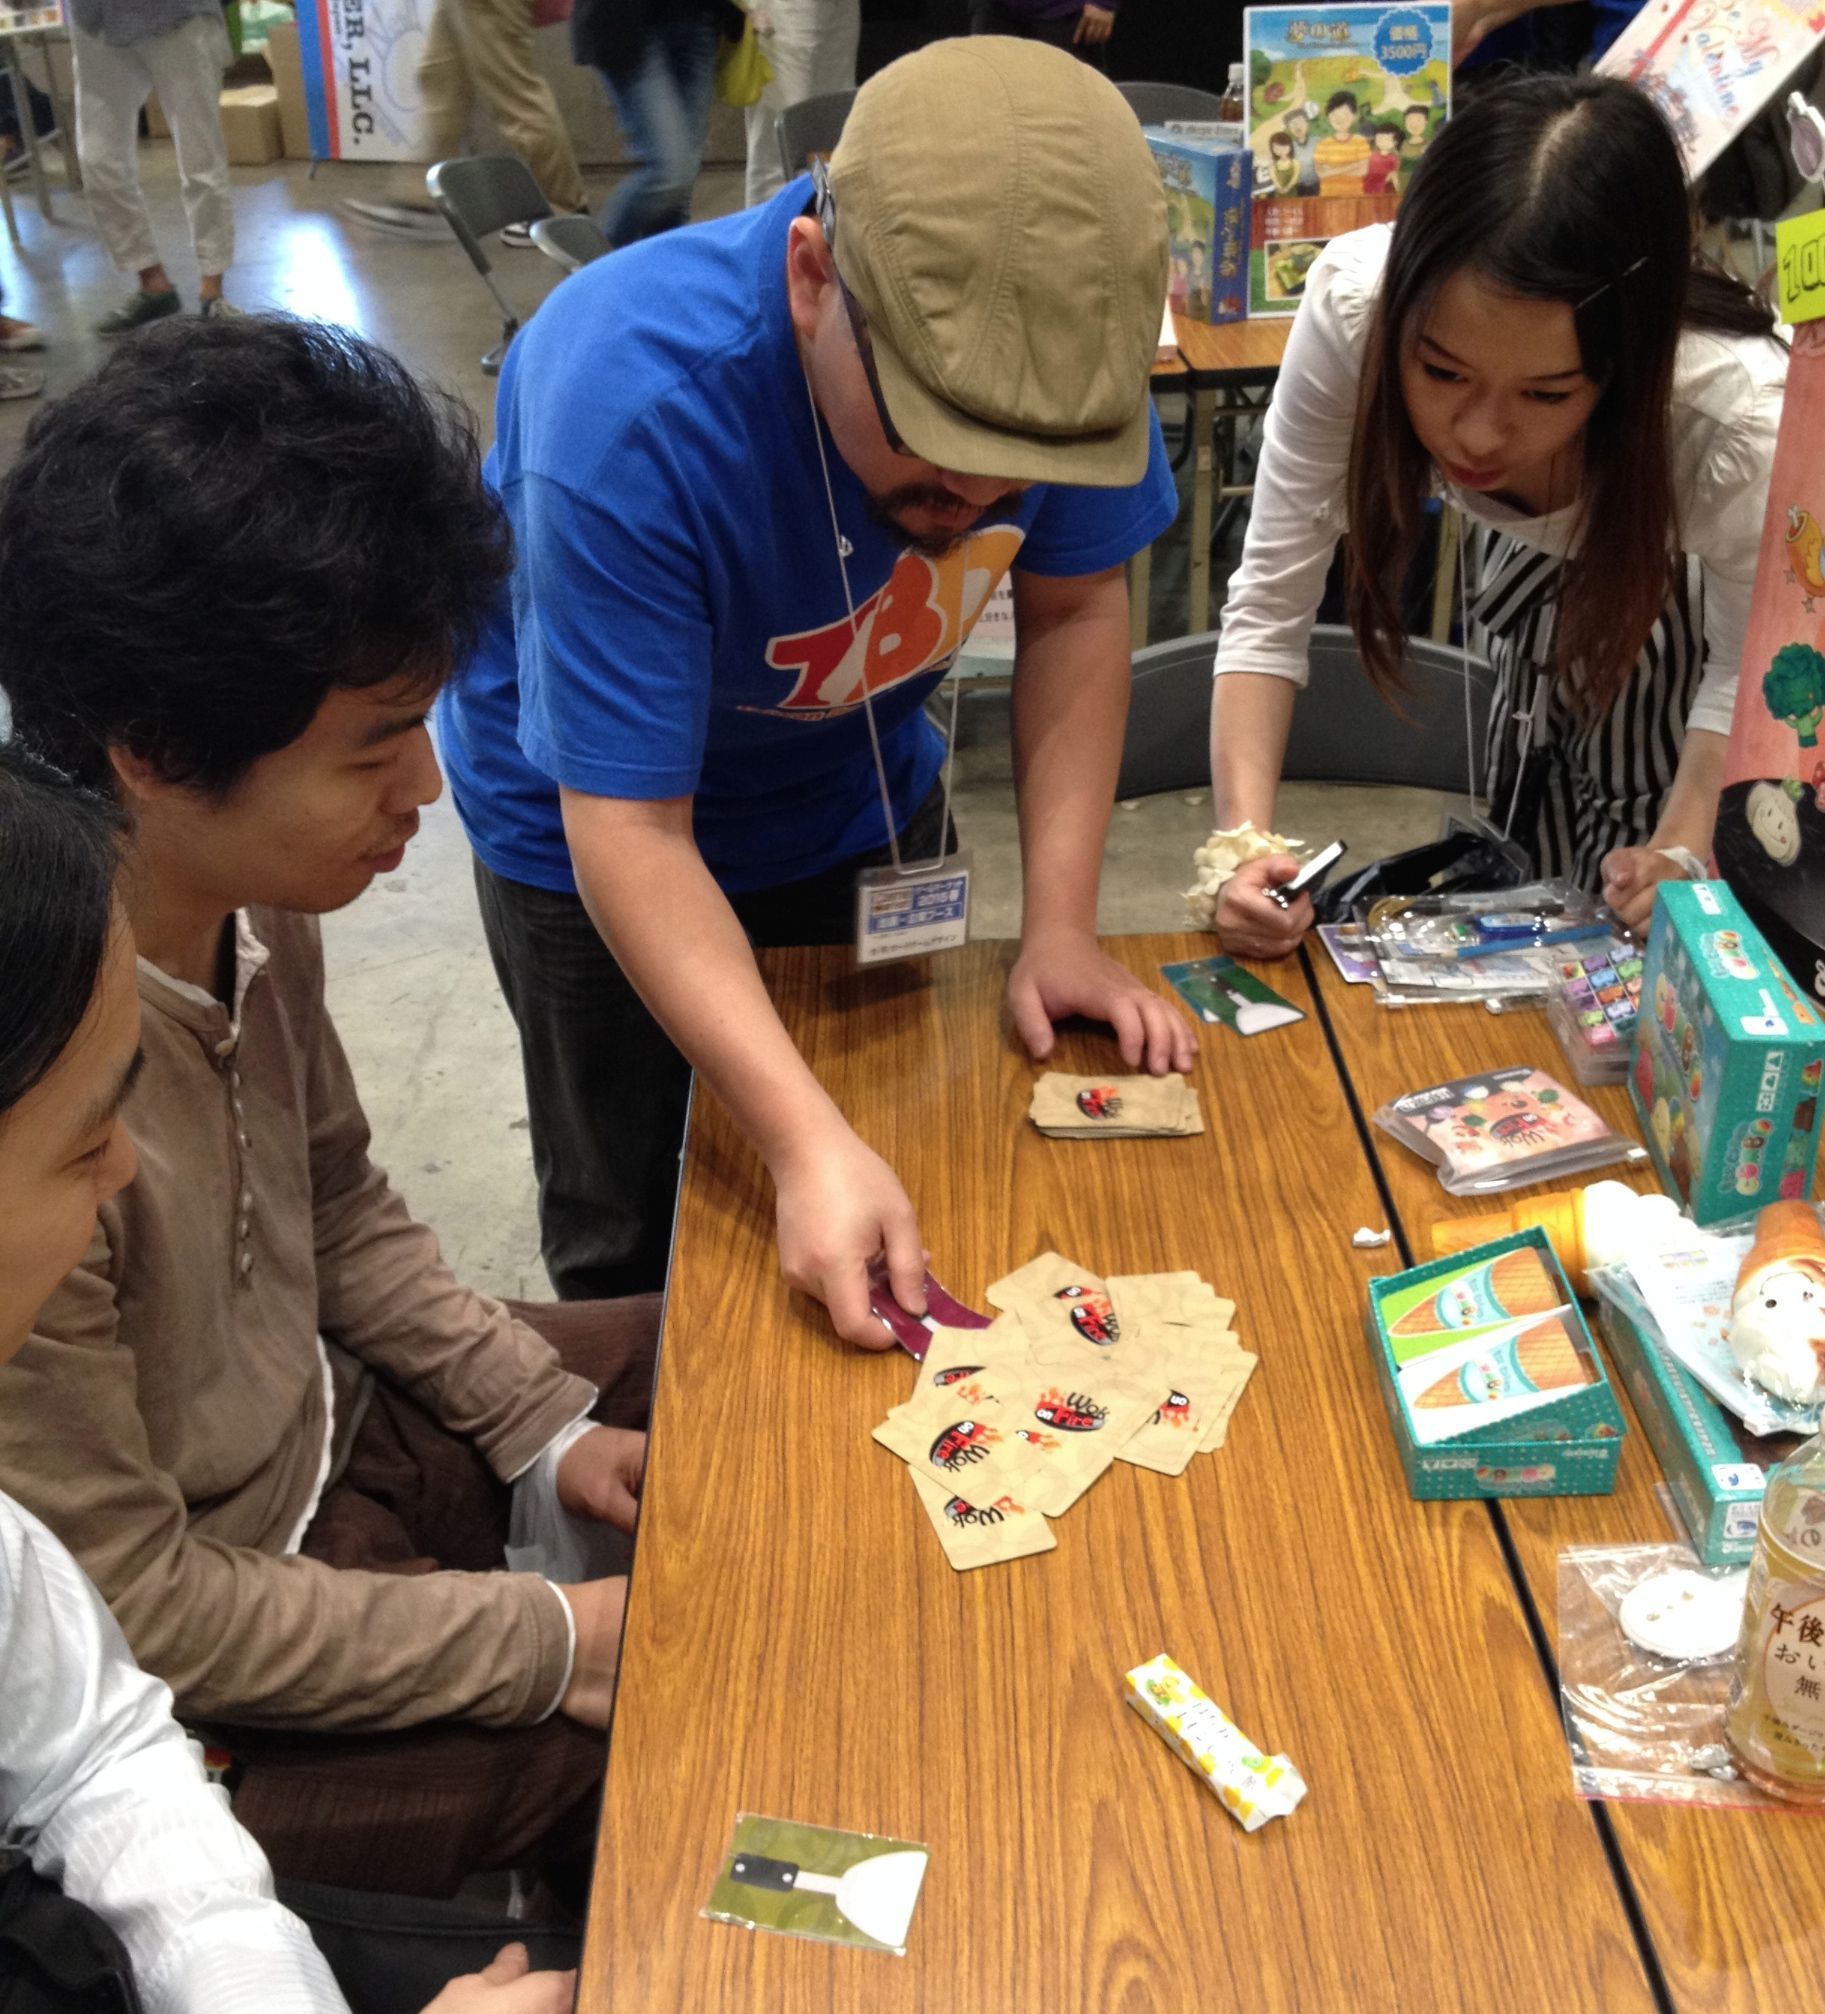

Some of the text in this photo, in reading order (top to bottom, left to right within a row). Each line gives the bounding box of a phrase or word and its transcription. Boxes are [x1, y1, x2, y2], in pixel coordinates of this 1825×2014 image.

[348, 57, 375, 146] LLC.
[1783, 238, 1825, 303] 10
[1053, 1407, 1084, 1428] Fire
[1065, 1392, 1111, 1419] Wok
[943, 1444, 990, 1473] Wok
[952, 1505, 1005, 1529] Wok
[1769, 1602, 1825, 1649] 午後
[1793, 1674, 1823, 1701] 無
